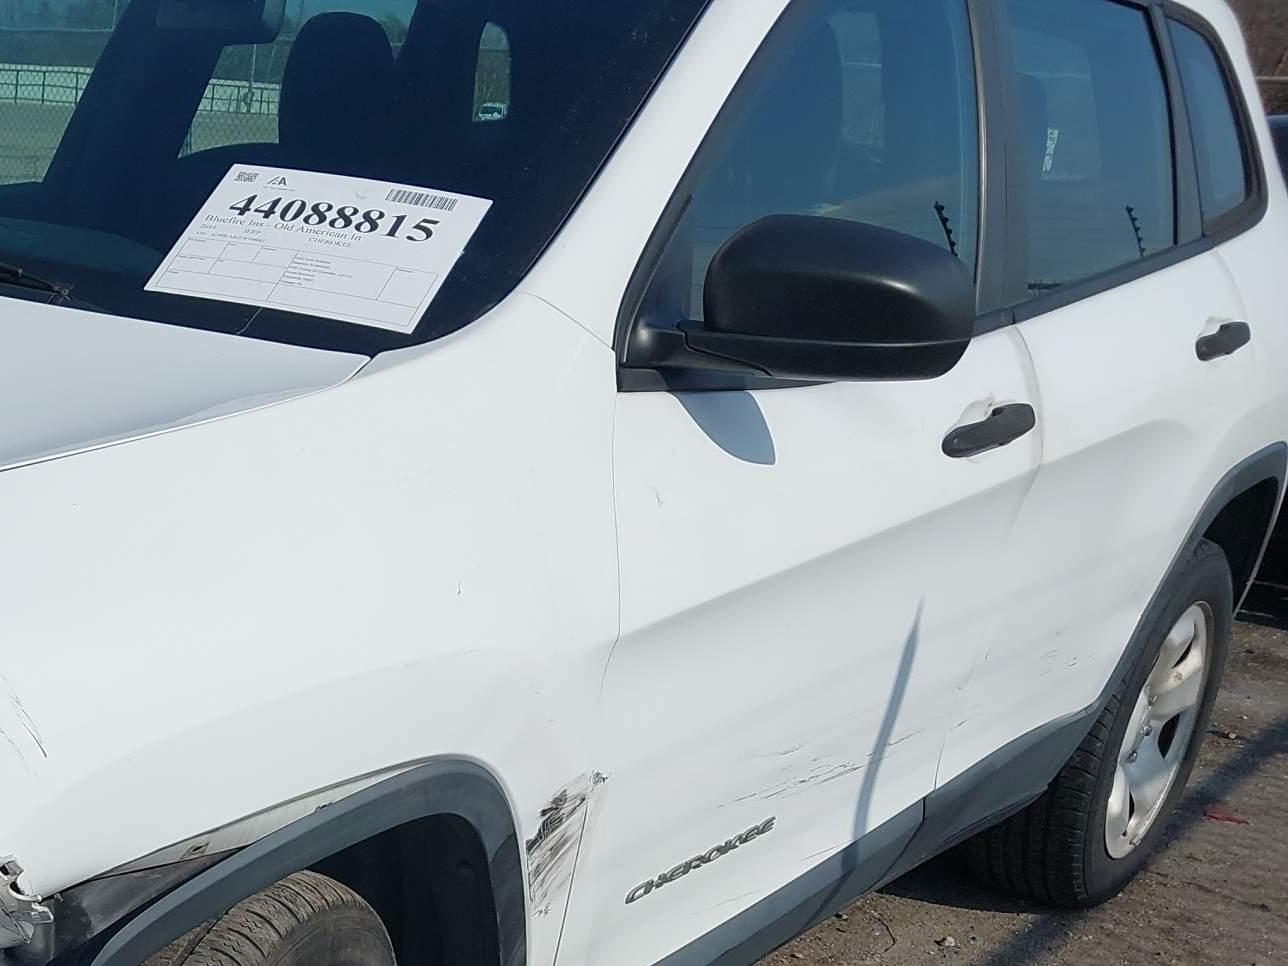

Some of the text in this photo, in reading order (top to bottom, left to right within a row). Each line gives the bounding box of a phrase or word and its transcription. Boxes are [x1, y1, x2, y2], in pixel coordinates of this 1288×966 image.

[204, 214, 247, 226] Bluefire
[248, 219, 265, 228] Ins
[274, 222, 295, 232] Old
[295, 225, 348, 239] American
[350, 233, 362, 242] In
[228, 193, 441, 242] 44088815
[308, 236, 354, 249] CHEROKEE
[624, 815, 777, 904] CHEROKEE
